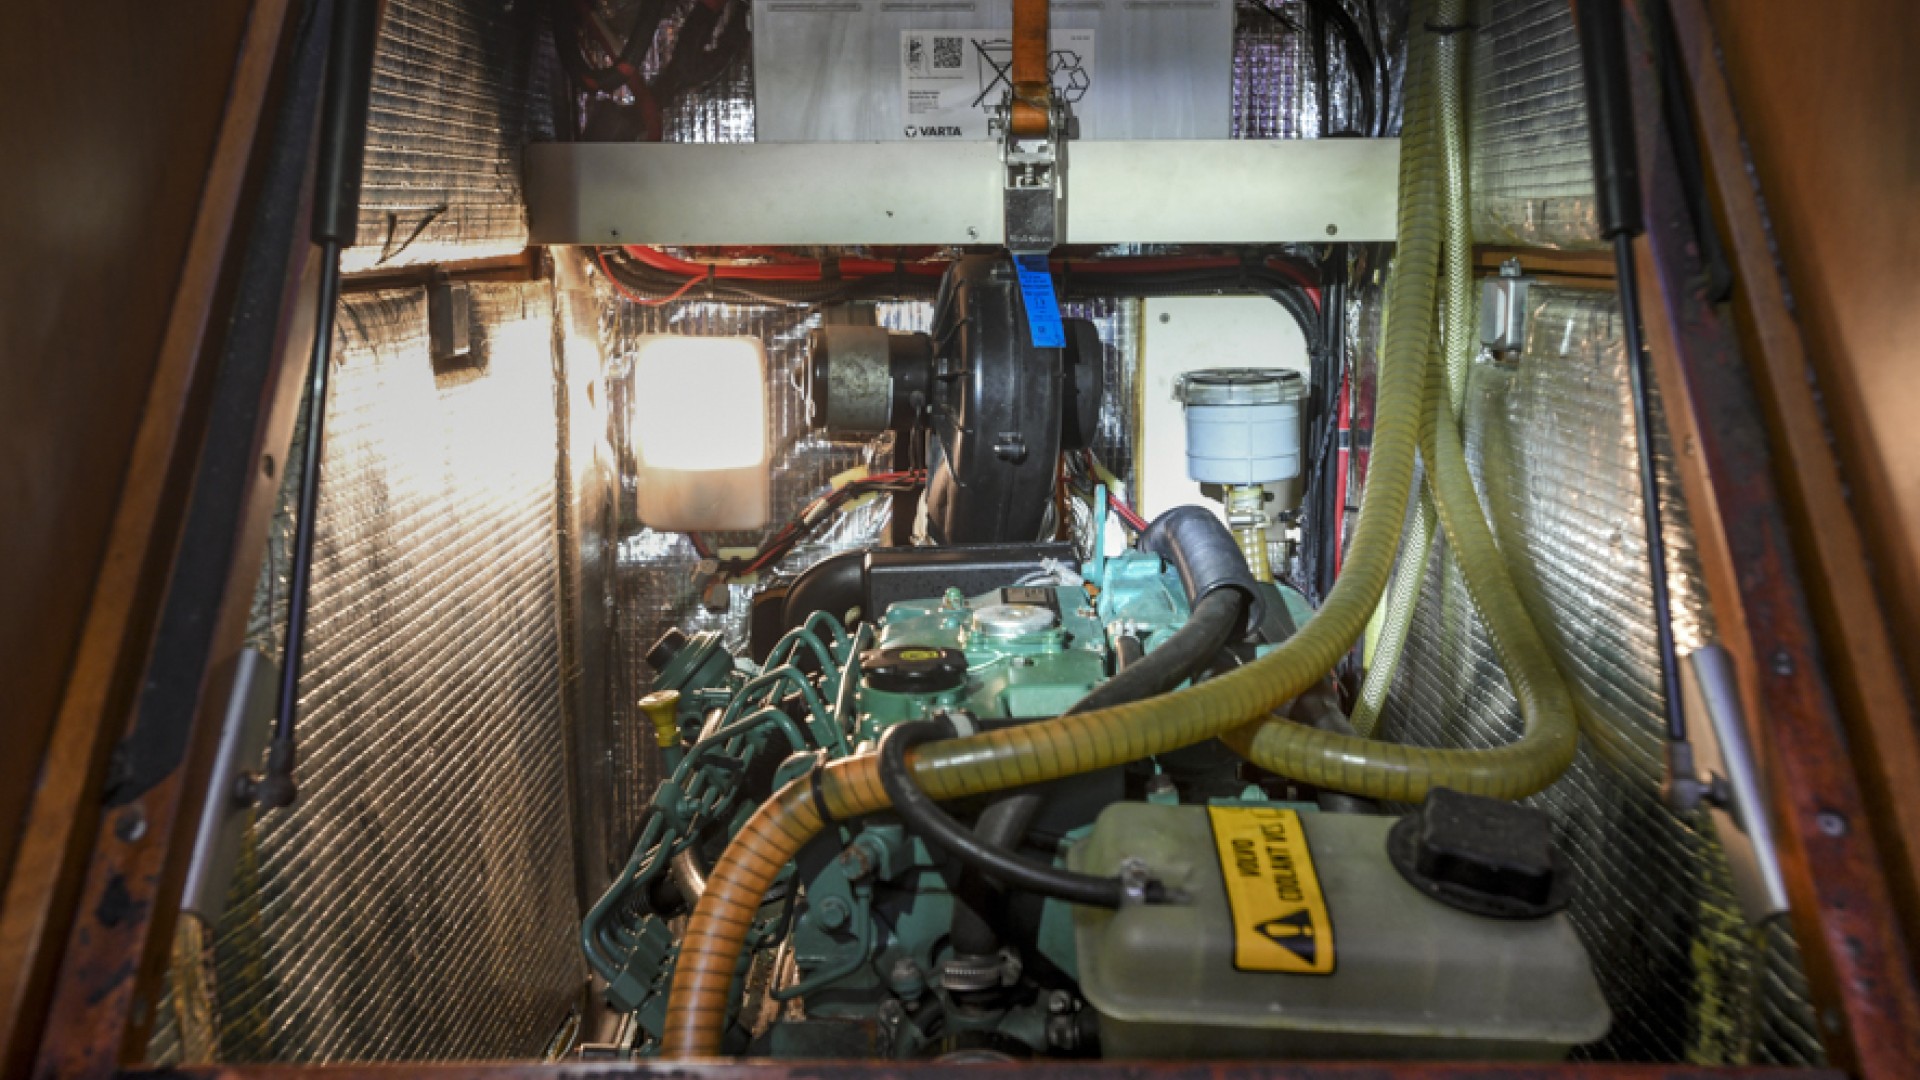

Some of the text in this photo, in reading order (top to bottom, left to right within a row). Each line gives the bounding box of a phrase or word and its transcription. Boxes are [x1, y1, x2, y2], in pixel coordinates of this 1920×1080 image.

[919, 126, 962, 136] VARTA
[1231, 839, 1261, 877] VOLVO
[1266, 846, 1304, 901] COOLANT
